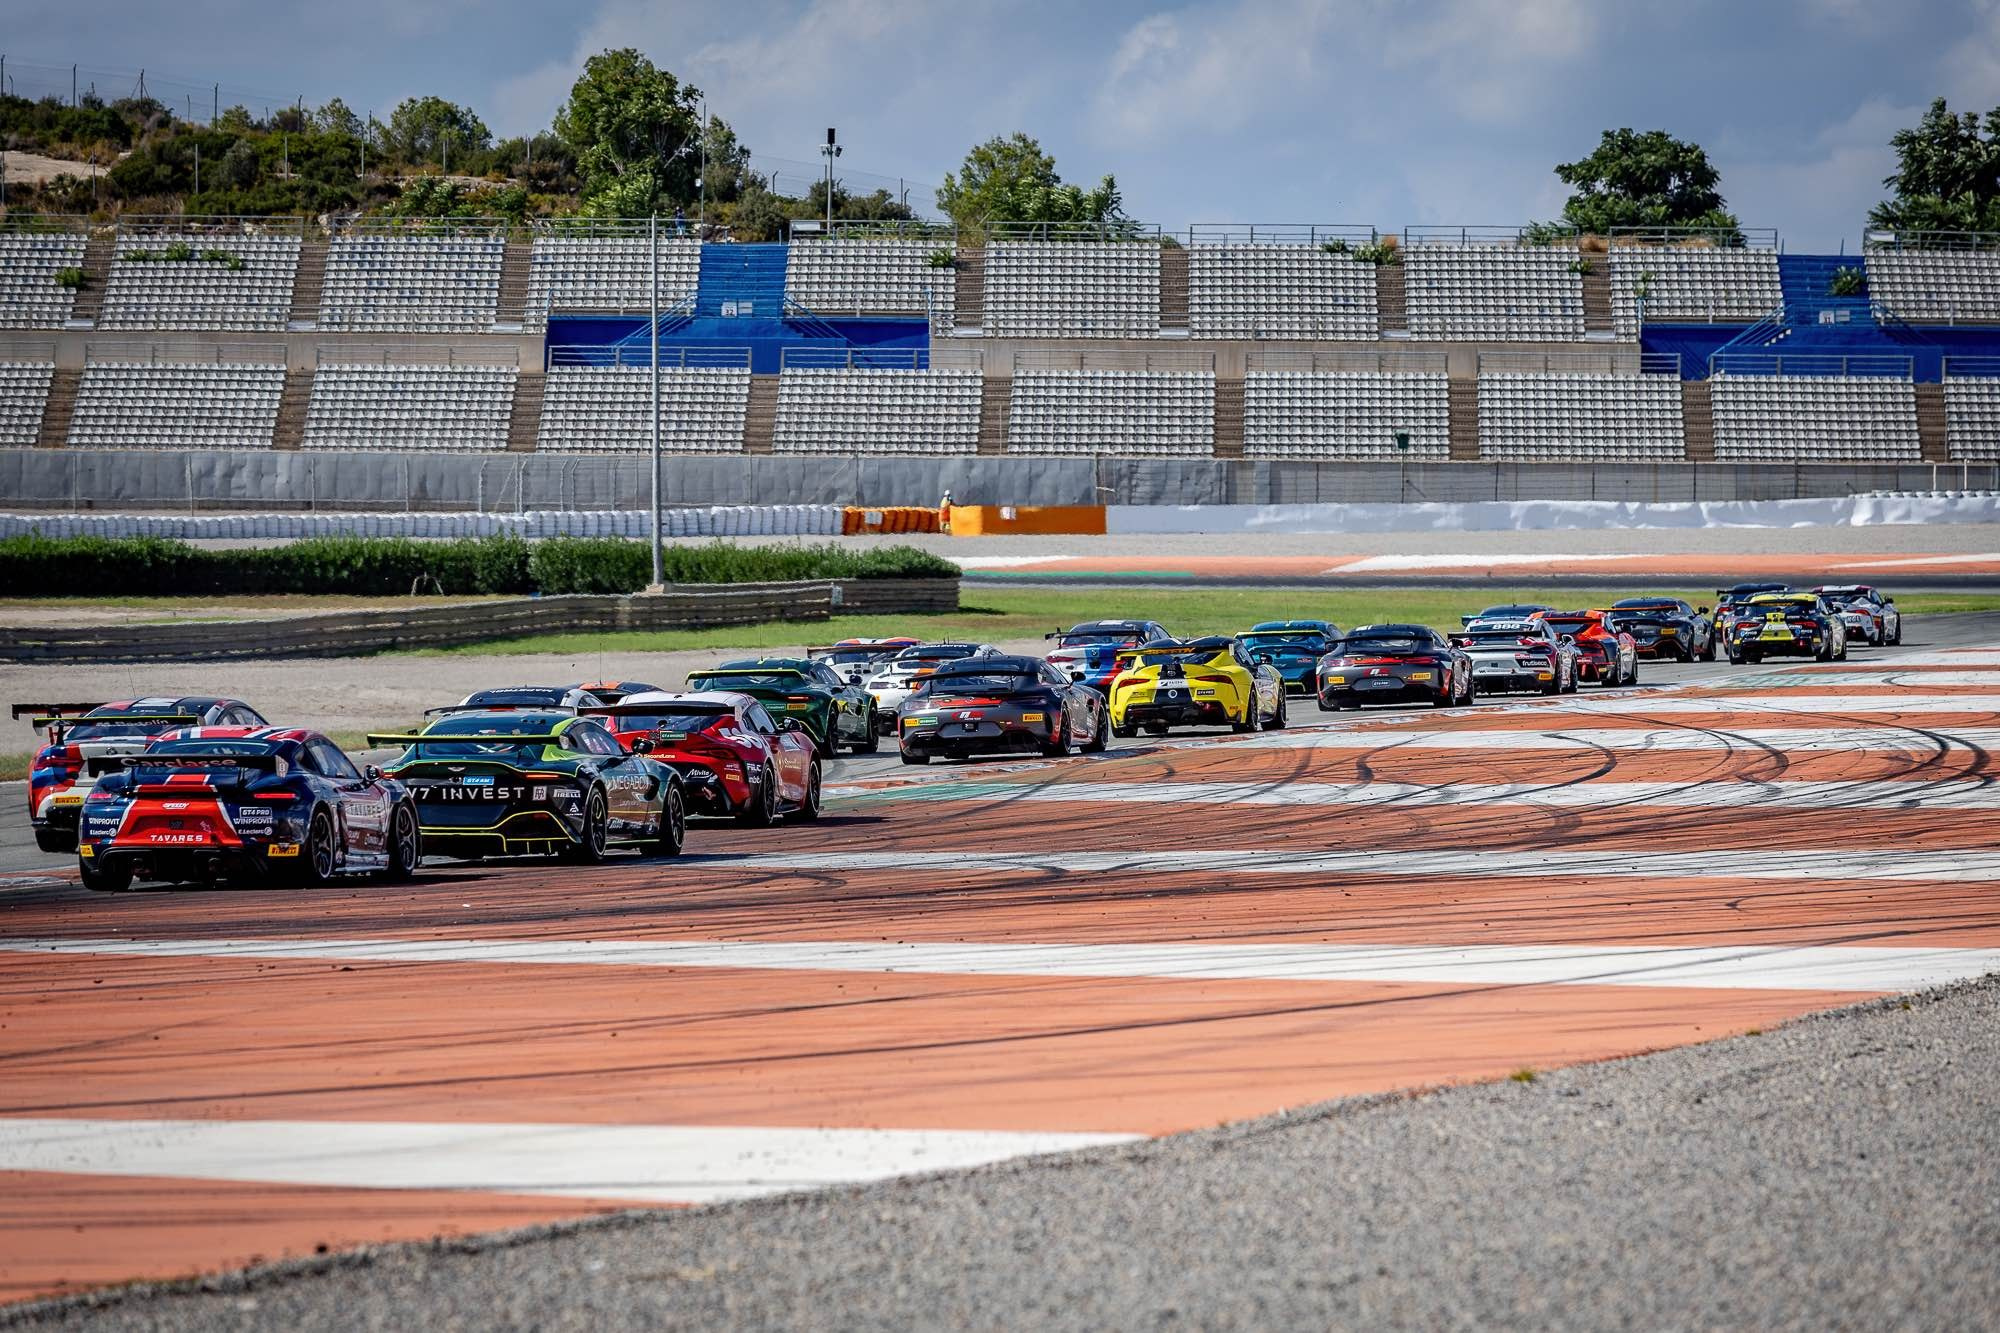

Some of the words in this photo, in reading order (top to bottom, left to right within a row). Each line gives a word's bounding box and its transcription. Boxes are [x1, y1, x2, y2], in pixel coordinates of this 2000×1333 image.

[120, 758, 237, 768] Carclasse
[442, 787, 525, 800] INVEST
[553, 788, 581, 798] PIRELLI
[233, 817, 273, 825] WINPROVIT
[150, 834, 203, 842] TAVARES
